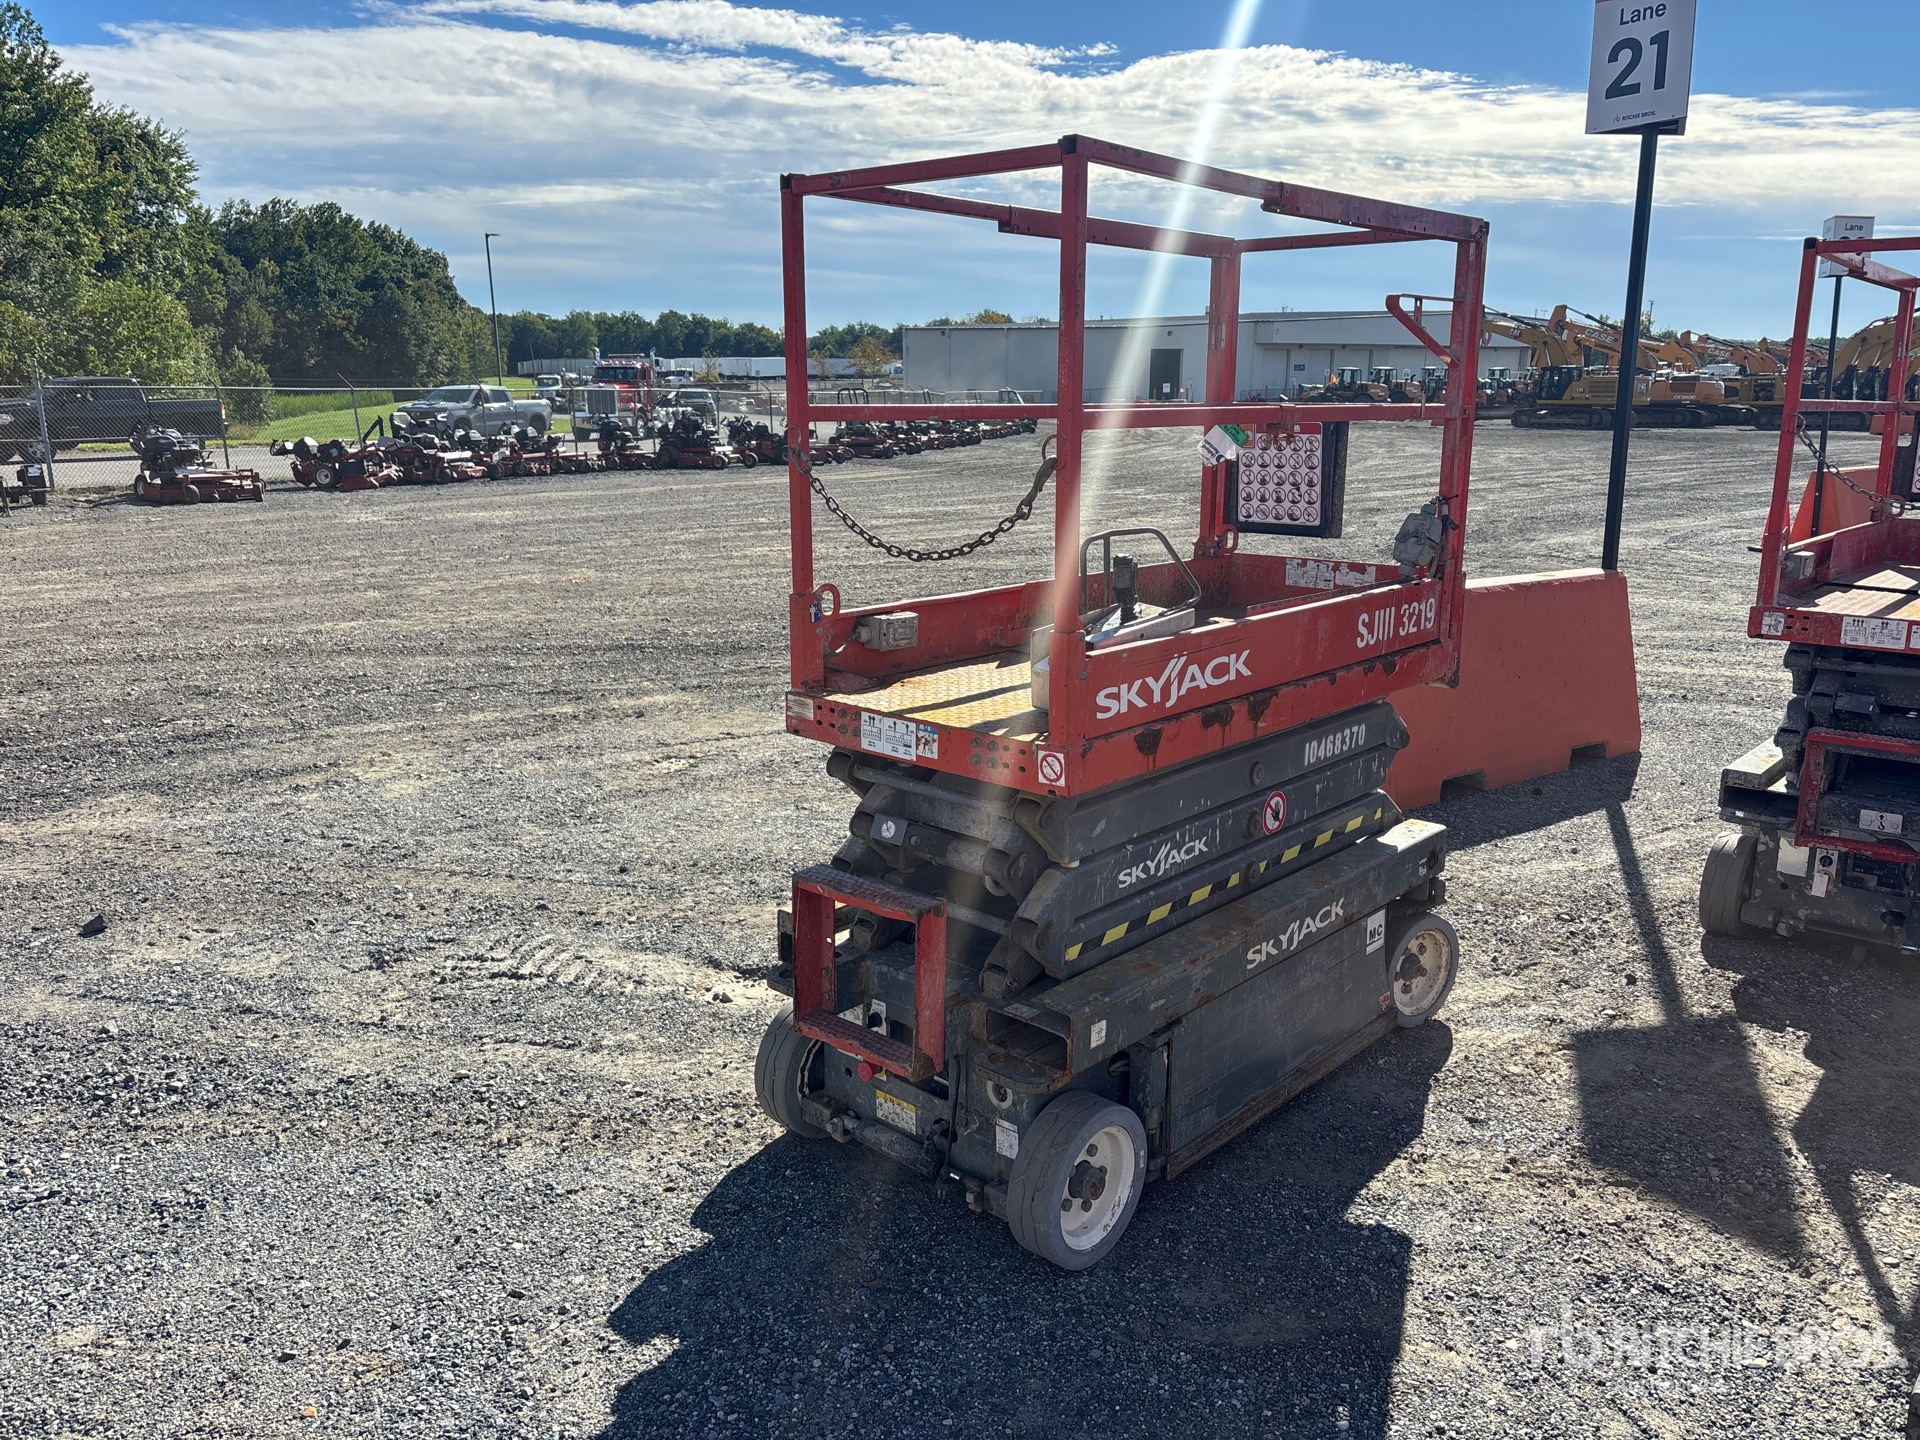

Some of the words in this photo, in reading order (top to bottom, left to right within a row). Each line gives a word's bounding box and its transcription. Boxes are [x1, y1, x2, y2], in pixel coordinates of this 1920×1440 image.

[1620, 3, 1667, 26] Lane
[1604, 29, 1670, 100] 21
[1621, 113, 1641, 121] RITCHIE
[1845, 222, 1864, 231] Lane
[1509, 328, 1521, 338] CAT
[1584, 328, 1615, 344] CASE
[1707, 347, 1732, 358] CASE
[1204, 438, 1220, 454] Rentals
[1399, 597, 1436, 637] 3219
[1095, 650, 1252, 720] SKYJACK
[1118, 835, 1209, 889] SKYJACK
[1246, 897, 1344, 970] SKYJACK
[1368, 923, 1383, 942] MC
